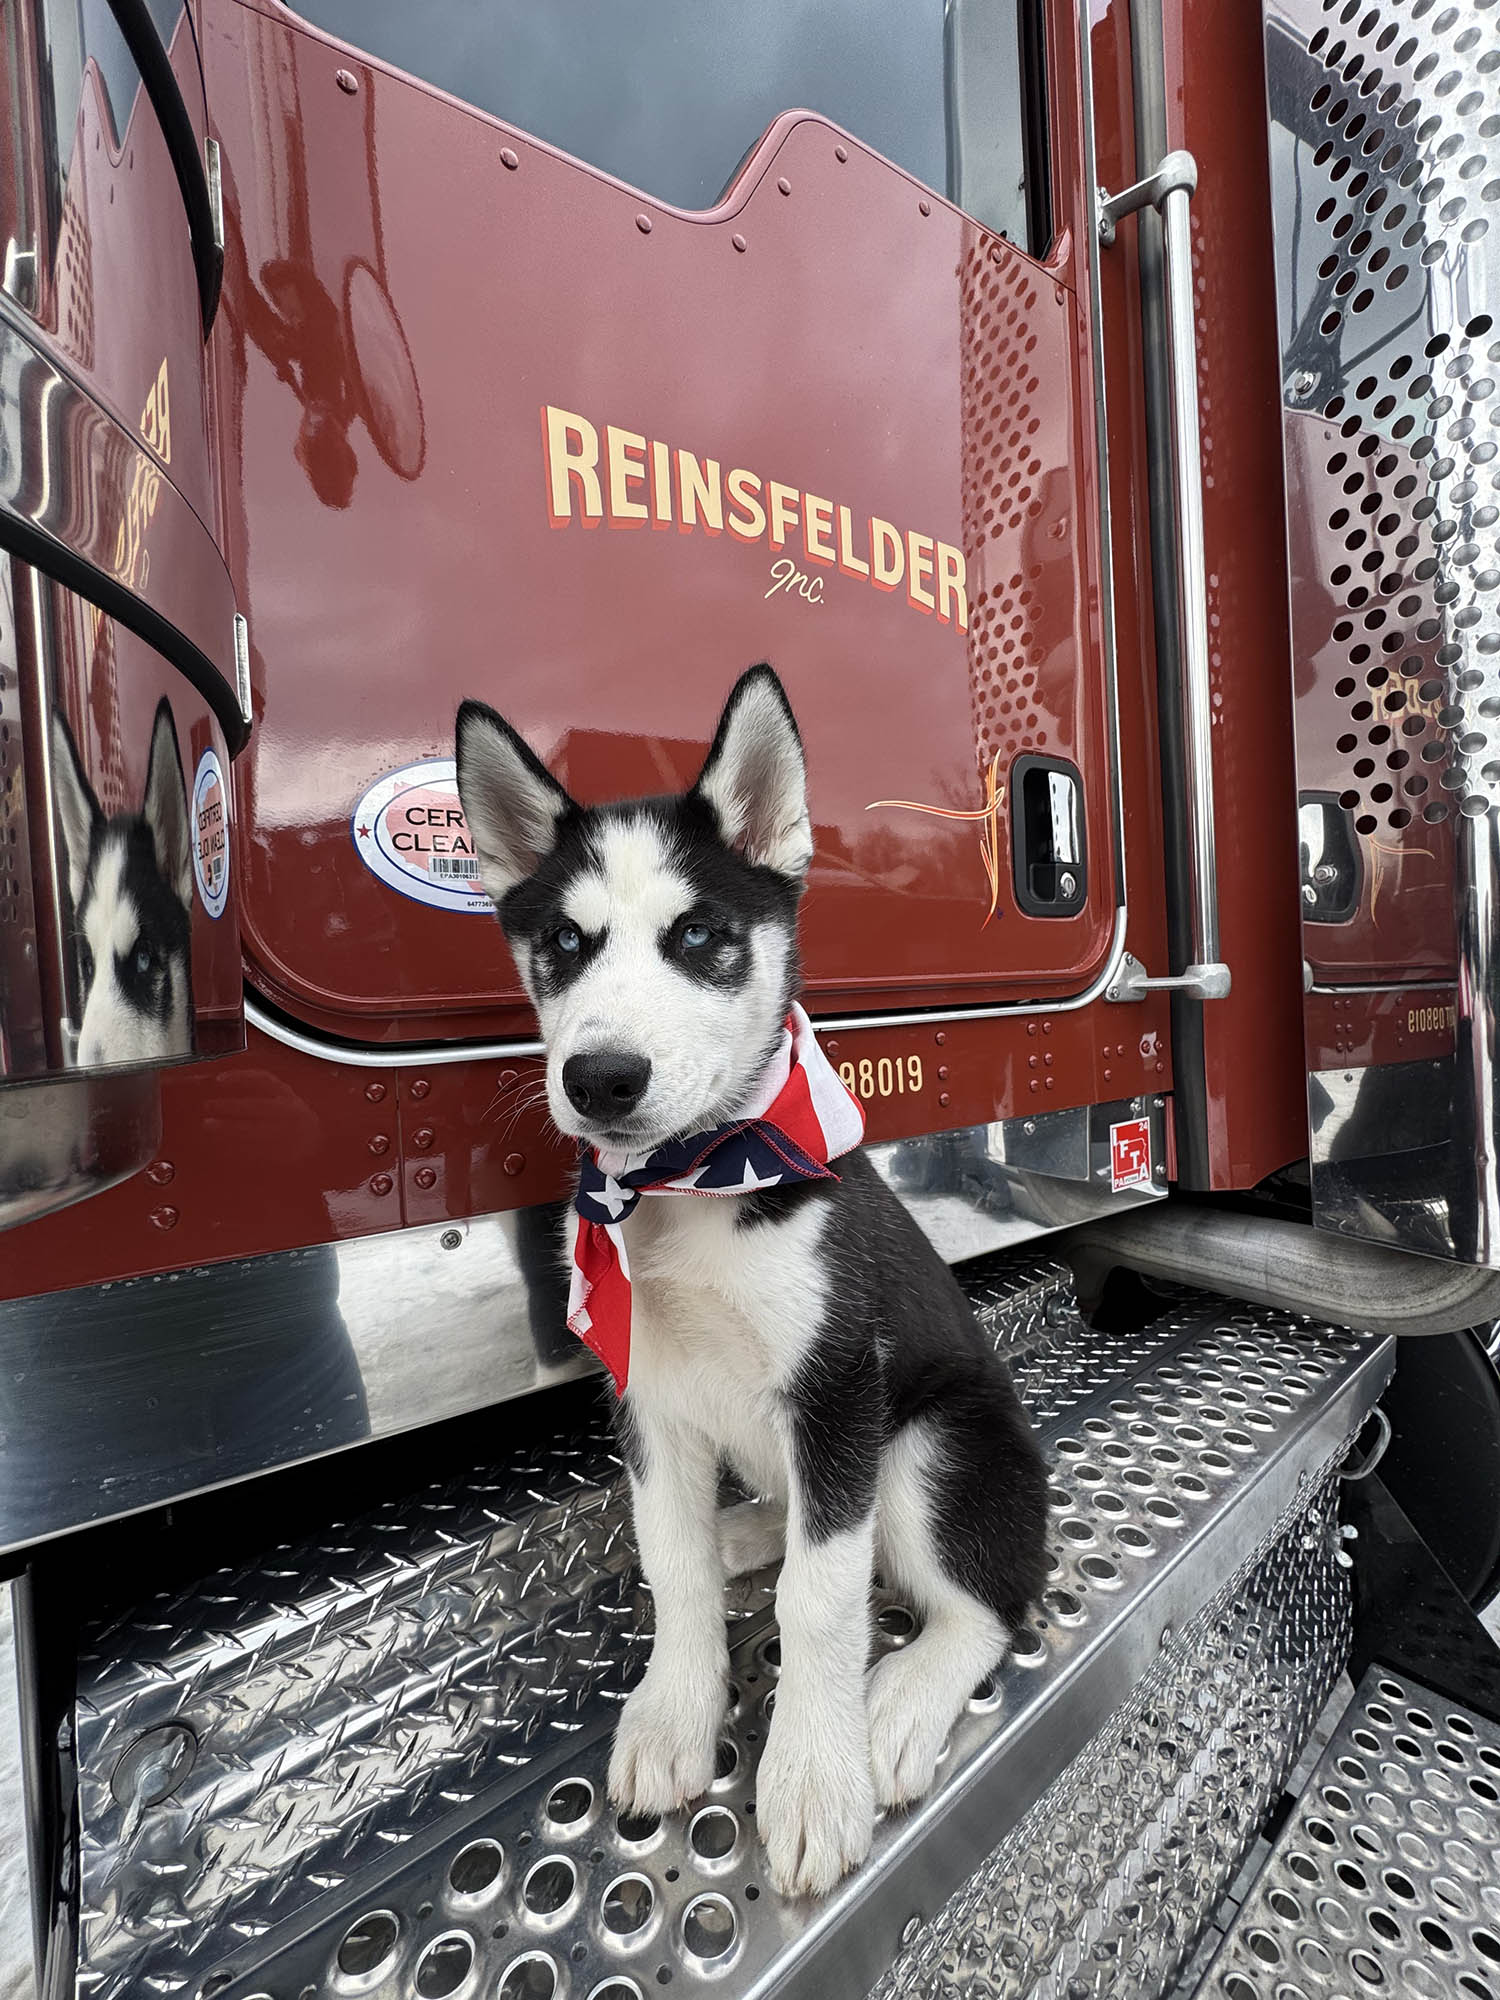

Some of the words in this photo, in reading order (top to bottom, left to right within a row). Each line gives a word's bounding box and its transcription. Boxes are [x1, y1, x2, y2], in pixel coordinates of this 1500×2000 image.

[541, 405, 969, 635] REINSFELDER
[764, 558, 825, 605] Inc.
[391, 833, 476, 854] CLEA
[839, 1055, 923, 1099] 98019
